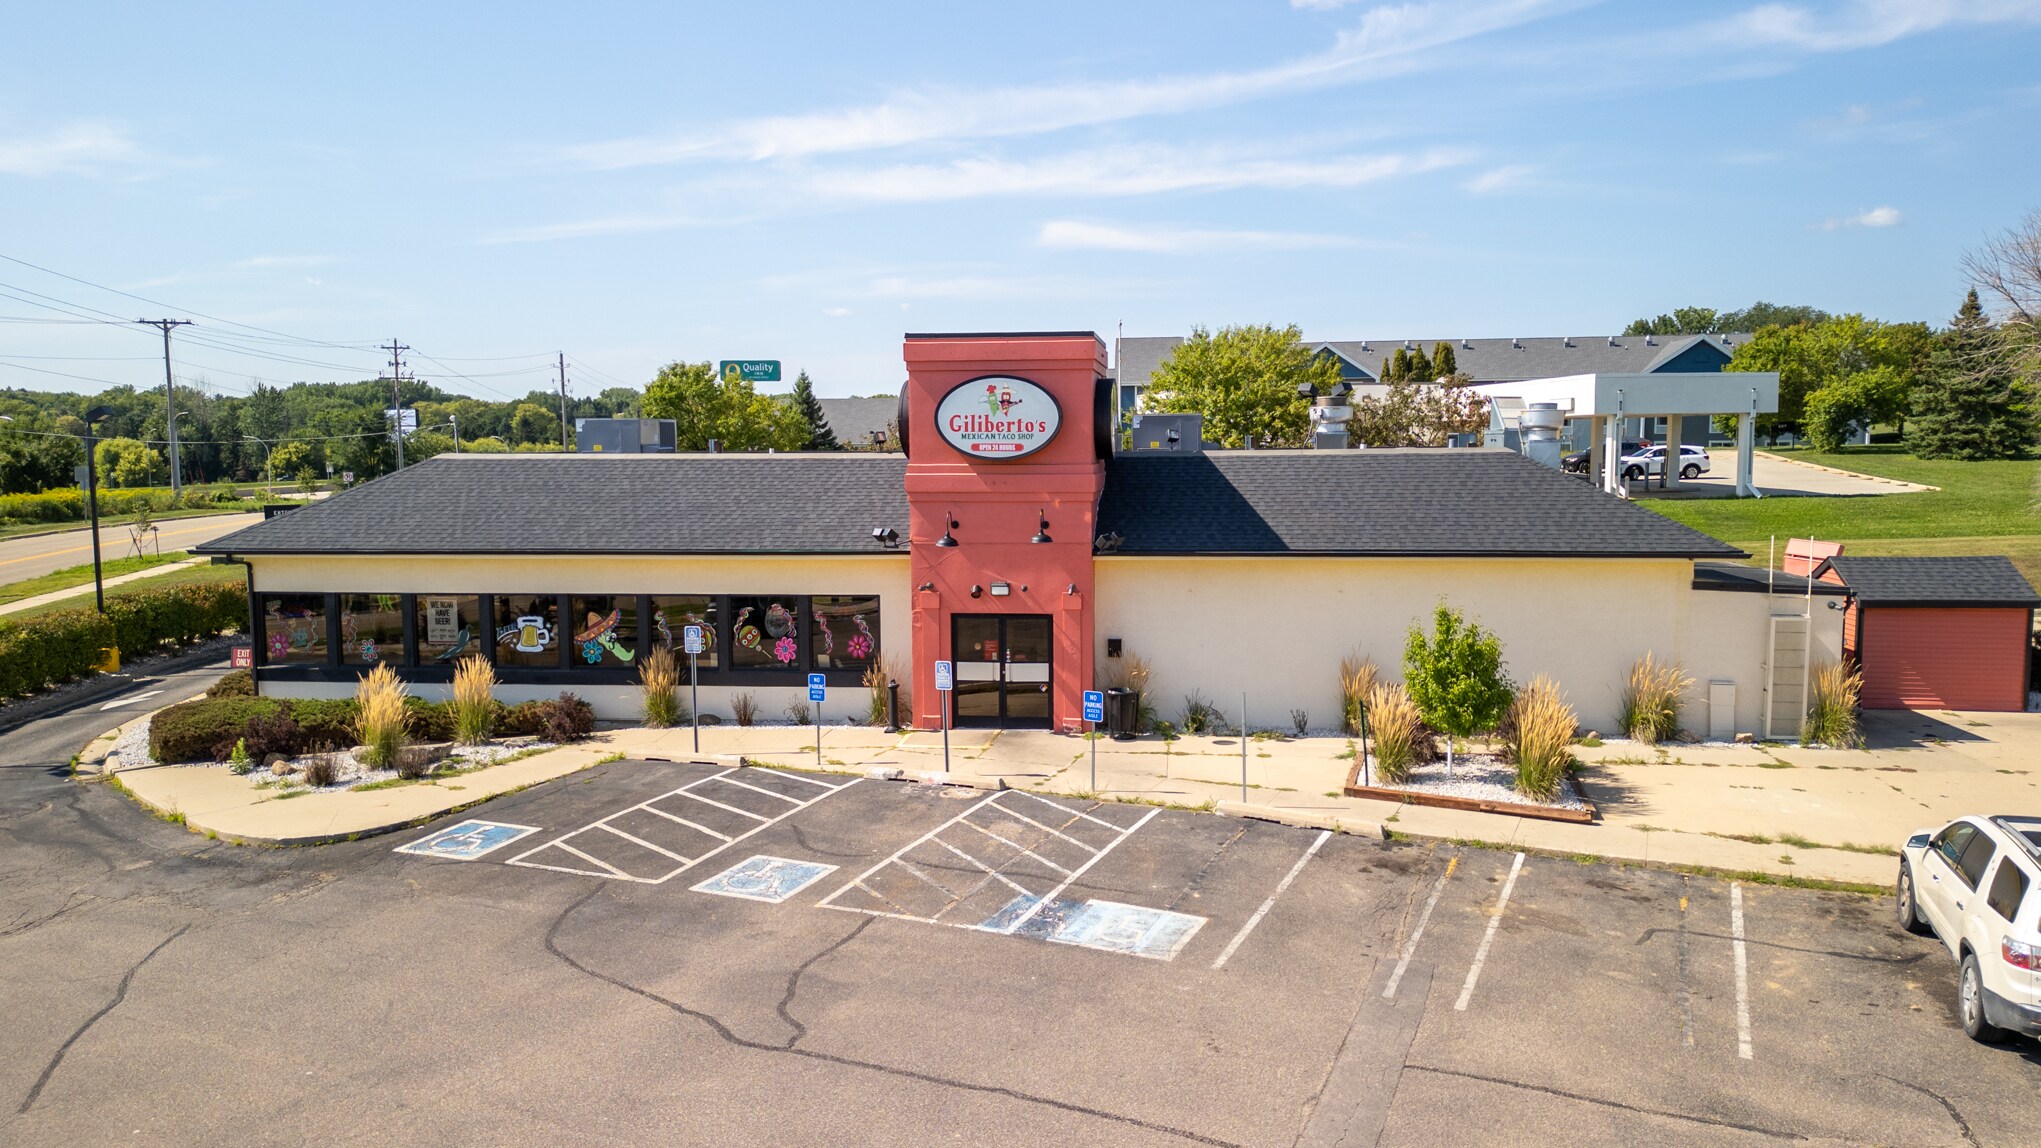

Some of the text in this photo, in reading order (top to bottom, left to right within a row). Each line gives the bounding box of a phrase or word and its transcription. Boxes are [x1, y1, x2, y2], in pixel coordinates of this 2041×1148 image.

[743, 363, 773, 373] Quality
[949, 414, 1046, 433] Giliberto's
[237, 649, 250, 657] EXIT
[235, 658, 250, 666] ONLY
